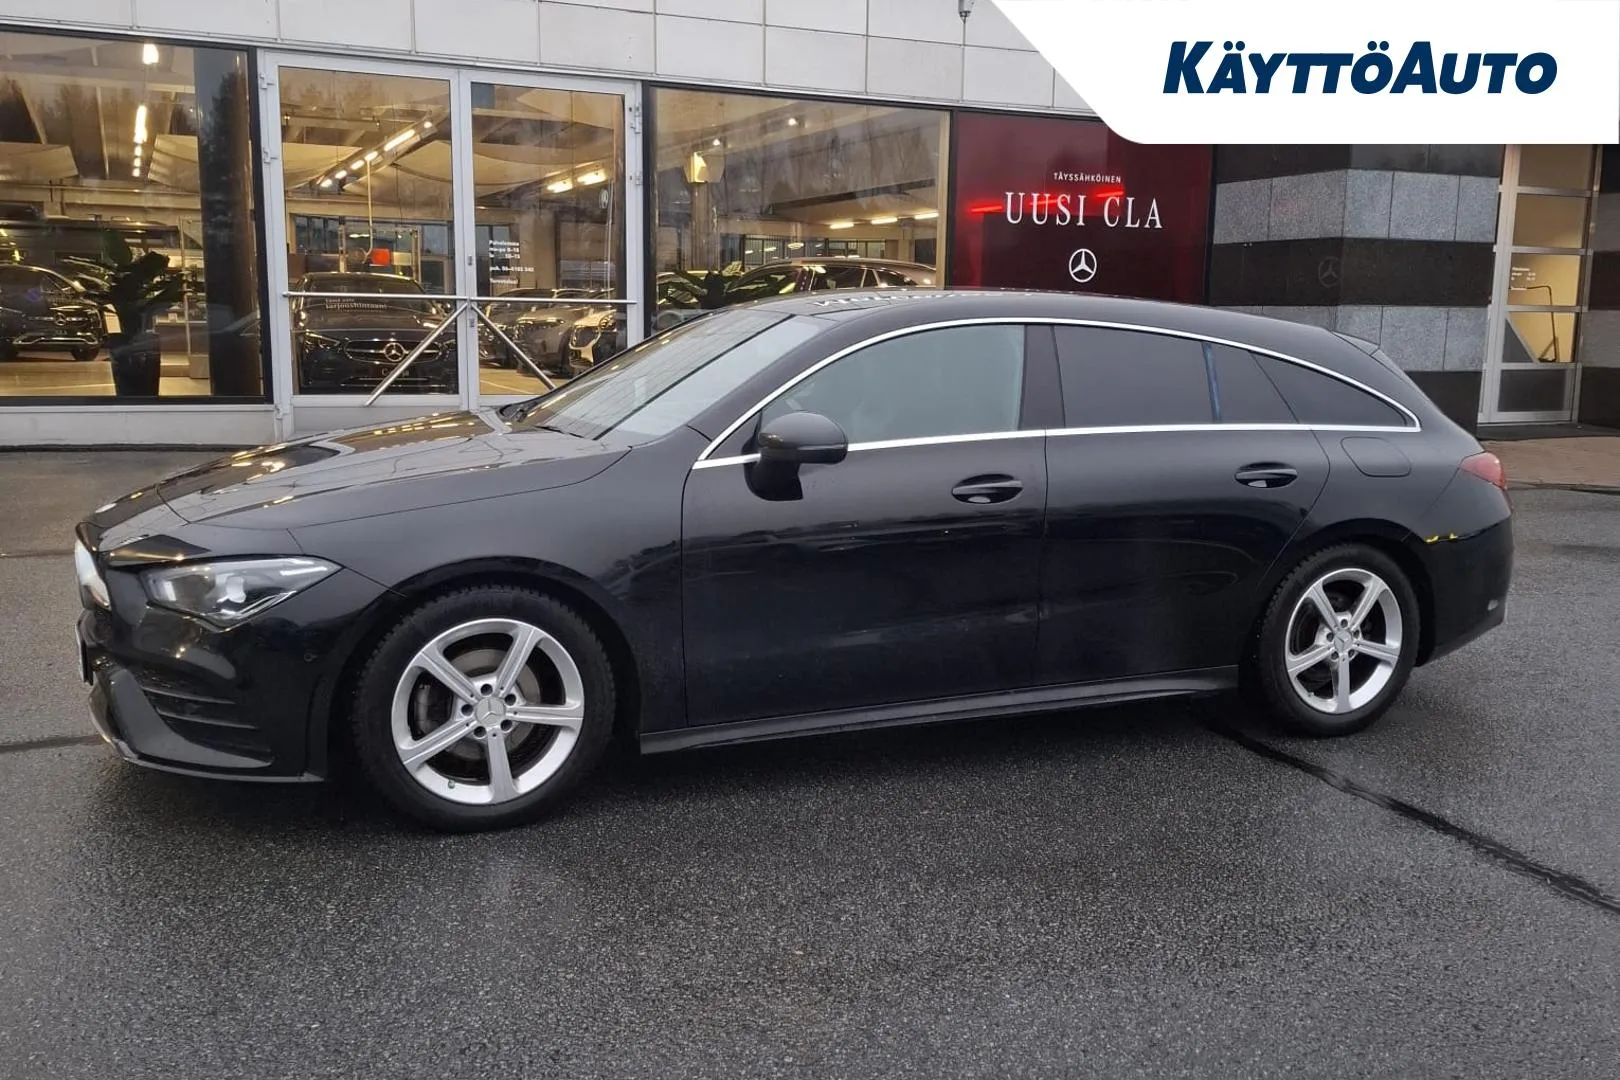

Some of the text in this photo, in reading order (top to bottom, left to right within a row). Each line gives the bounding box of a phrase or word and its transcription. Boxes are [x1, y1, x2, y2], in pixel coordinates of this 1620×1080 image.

[1053, 172, 1121, 184] TÄYSSÄHKÖINEN
[1005, 191, 1162, 229] UUSI CLA
